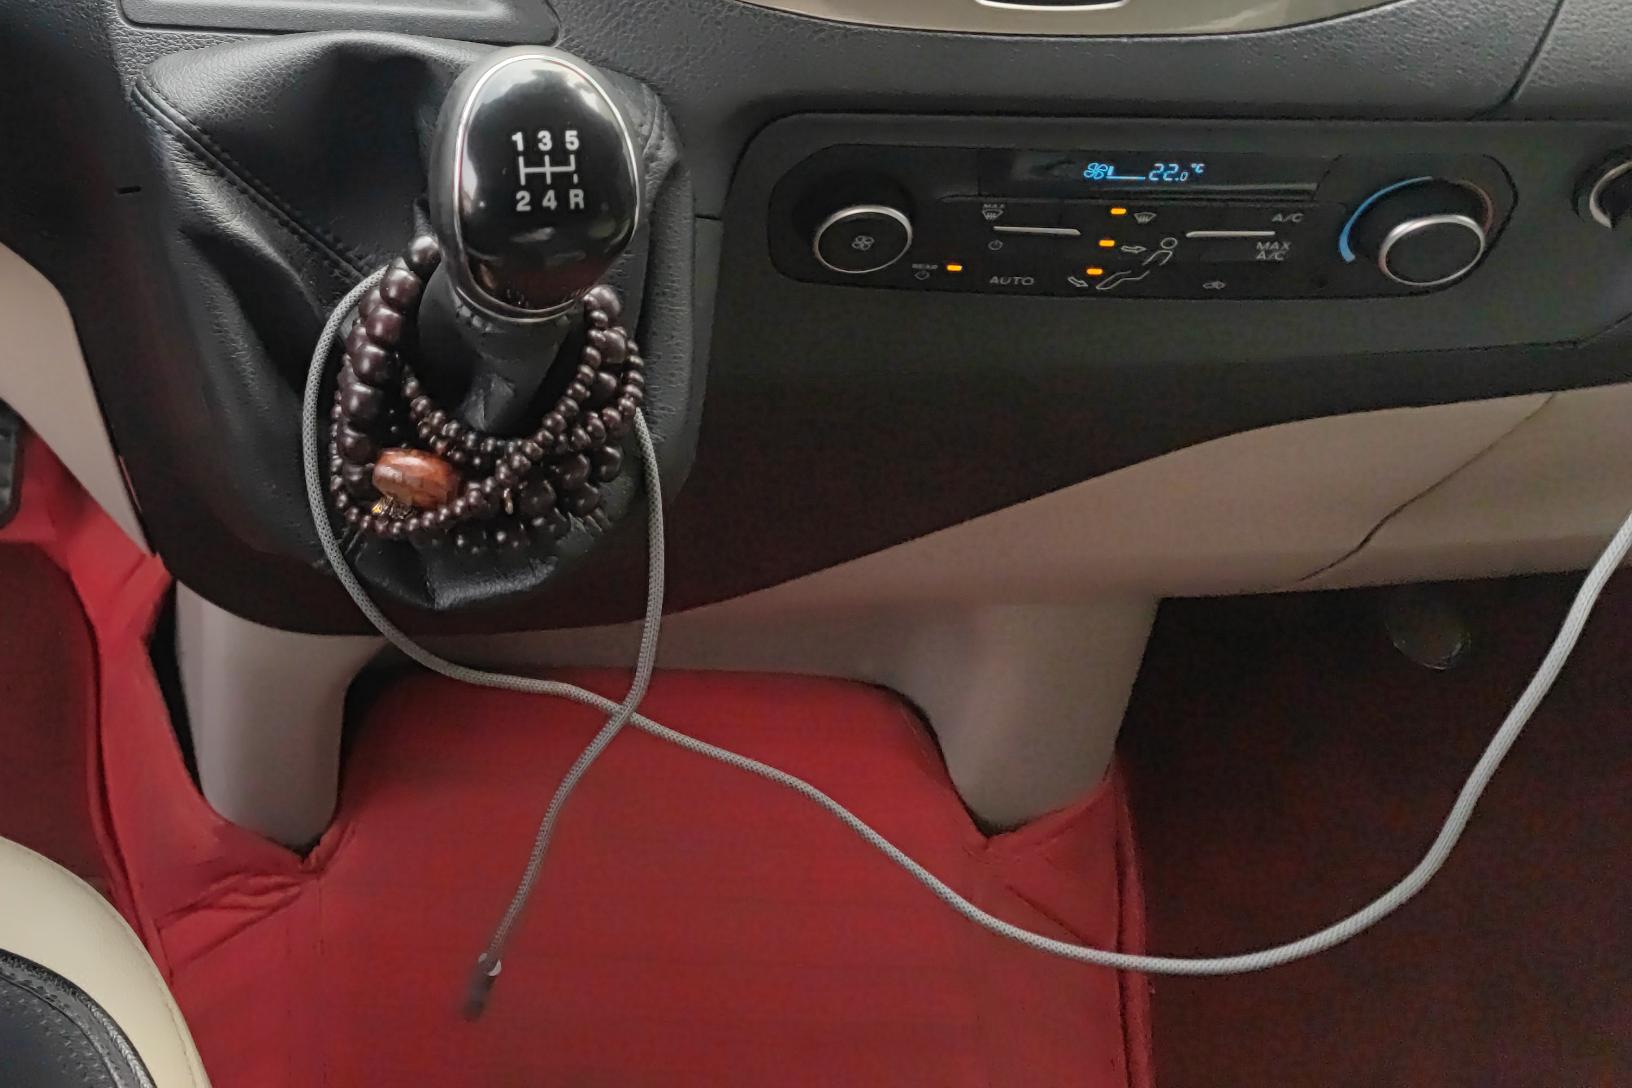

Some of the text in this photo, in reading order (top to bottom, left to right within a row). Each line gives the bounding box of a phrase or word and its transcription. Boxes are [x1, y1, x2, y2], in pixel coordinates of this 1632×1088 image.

[511, 130, 580, 152] 1 3 5
[516, 189, 585, 211] 2 4 R
[1271, 213, 1305, 223] A/C
[1256, 241, 1292, 251] MAX
[1256, 251, 1286, 261] A/C
[989, 276, 1035, 286] AUTO
